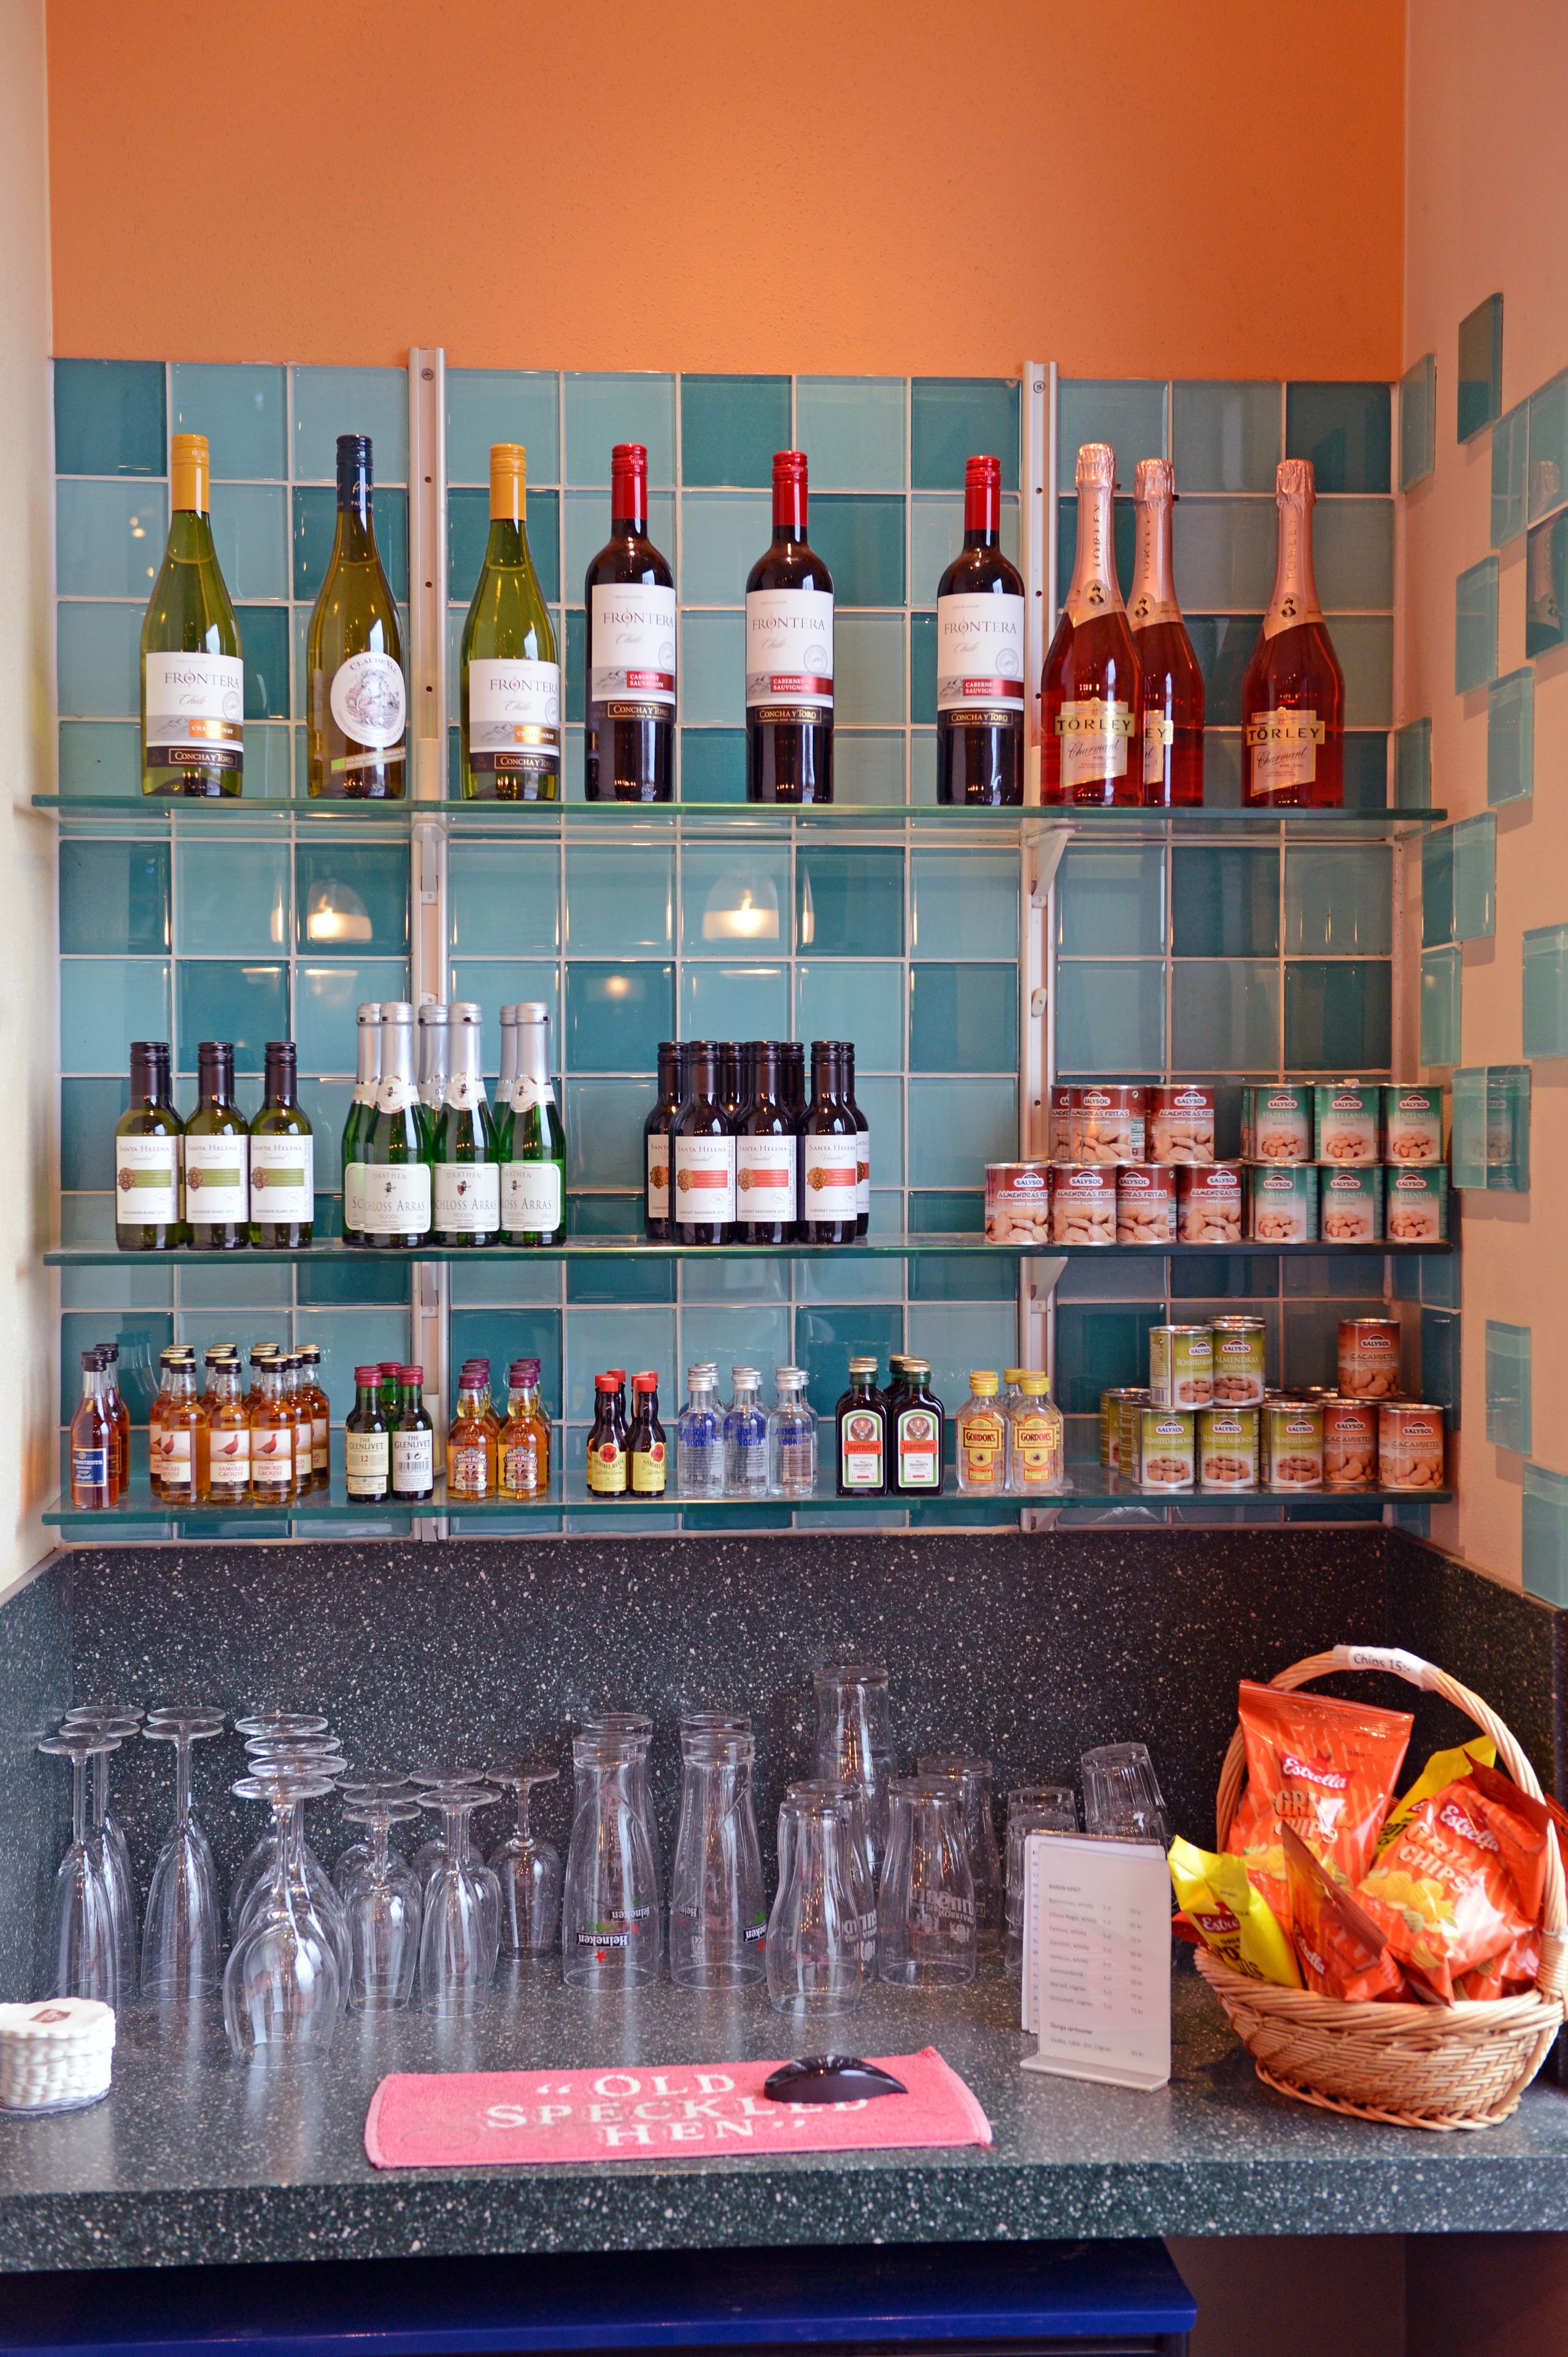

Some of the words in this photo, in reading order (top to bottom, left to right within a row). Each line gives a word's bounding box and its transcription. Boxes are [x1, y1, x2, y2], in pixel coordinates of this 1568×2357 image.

[1092, 505, 1101, 569] TÖRLEY
[603, 612, 674, 628] FRONTERA
[752, 616, 825, 632] FRONTERA
[944, 620, 1017, 635] FRONTERA
[616, 633, 643, 644] Chile
[761, 638, 787, 651] Chile
[953, 643, 979, 654] Chile
[164, 671, 240, 689] FRONTERA
[490, 678, 558, 695] FRONTERA
[178, 694, 207, 705] Chile
[503, 700, 532, 712] Chile
[614, 705, 647, 714] CONCHA
[653, 706, 668, 717] TORO
[760, 710, 791, 719] CONCHA
[797, 709, 817, 719] TORO
[951, 713, 983, 722] CONCHA
[989, 713, 1008, 722] TORO
[1057, 717, 1131, 731] TÖRLEY
[1248, 726, 1321, 741] TÖRLEY
[1068, 740, 1120, 761] Charmant
[1256, 746, 1307, 768] Charmant
[175, 751, 210, 761] CONCHA
[217, 754, 234, 764] TORO
[500, 757, 533, 767] CONCHA
[1262, 1111, 1303, 1120] HAZELNUTS
[1327, 1111, 1369, 1120] AVELLANAS
[1394, 1111, 1435, 1120] HAZELNUTS
[396, 1200, 425, 1212] ARRAS
[471, 1199, 496, 1210] ARRAS
[522, 1198, 552, 1210] ARRAS
[686, 1439, 711, 1447] VODKA
[966, 1432, 996, 1442] GORDON'S
[1021, 1432, 1052, 1442] GORDON'S
[394, 1439, 431, 1449] GLENLIVET
[1283, 1757, 1347, 1789] Estrella
[1439, 1804, 1499, 1852] Estrella
[1398, 1844, 1469, 1893] CHIPS
[612, 1906, 651, 1920] Heineken
[1201, 1915, 1241, 1932] Estre
[578, 1933, 628, 1947] Heineken
[487, 2092, 870, 2129] SPECKLED
